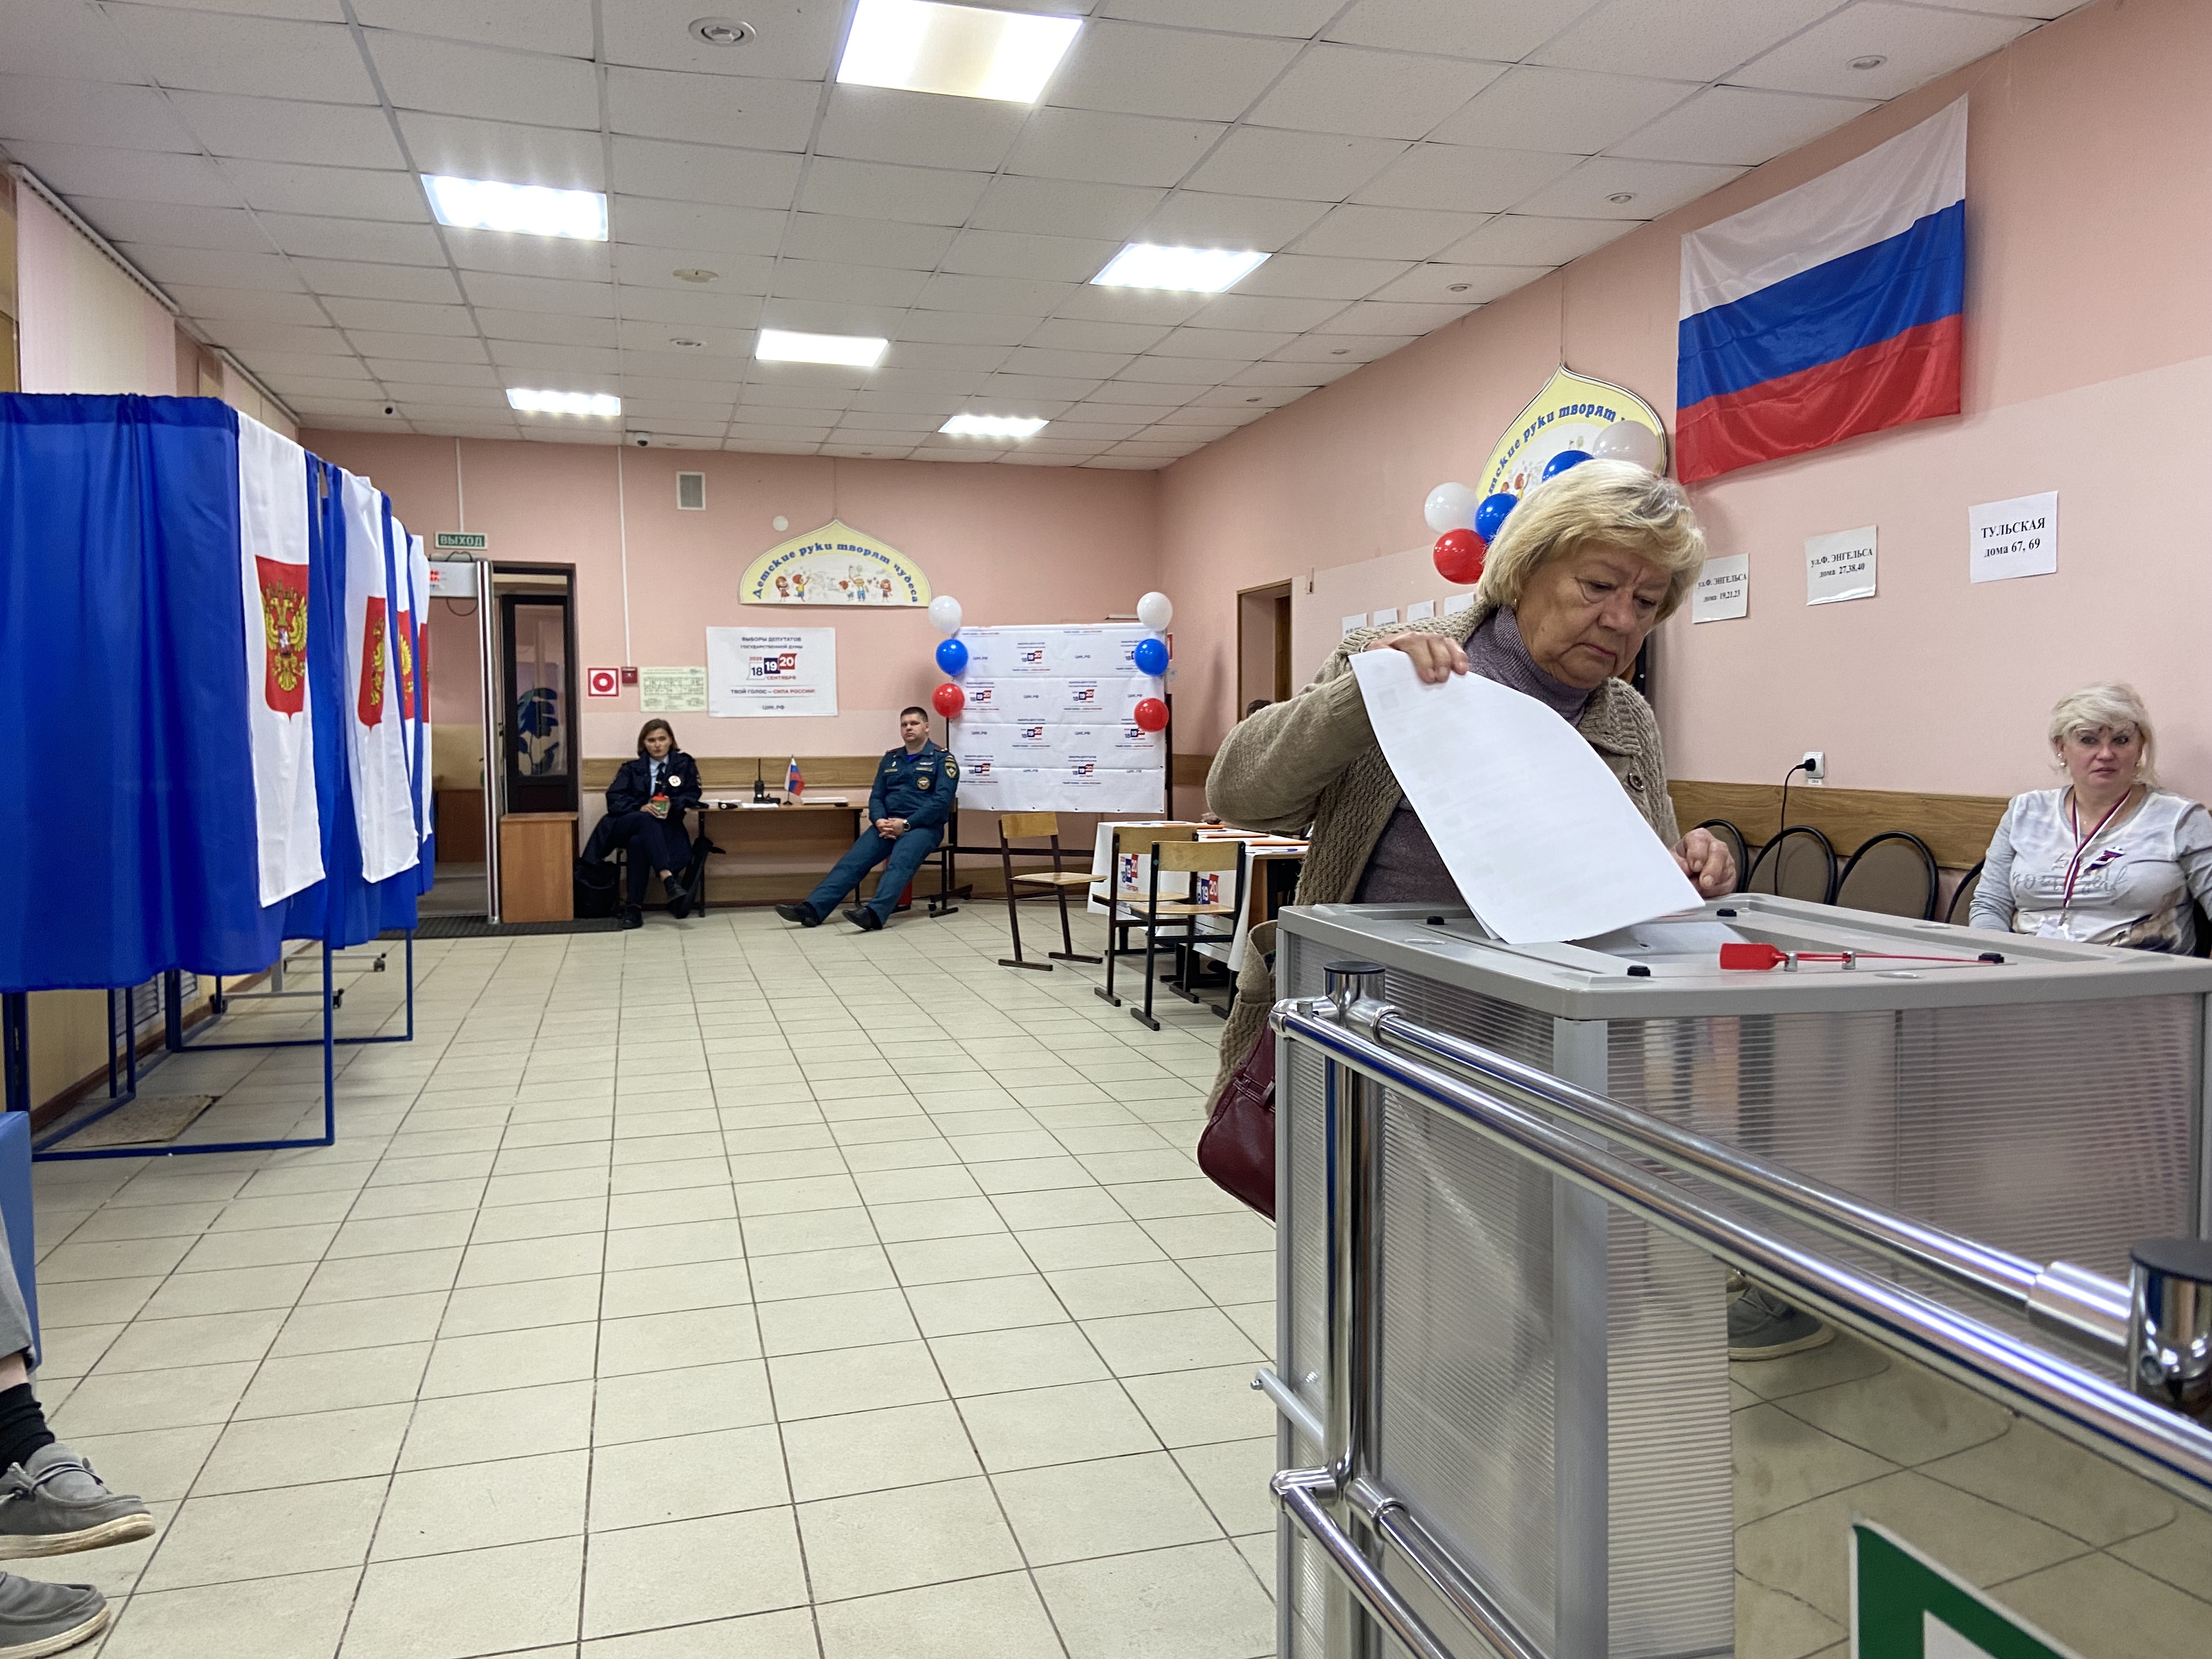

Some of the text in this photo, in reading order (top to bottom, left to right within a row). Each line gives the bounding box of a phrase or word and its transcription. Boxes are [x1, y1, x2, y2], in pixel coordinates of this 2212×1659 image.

[1487, 404, 1616, 495] тские руки творят
[1981, 517, 2046, 538] ТУЛЬСКАЯ
[440, 535, 482, 545] ВЫХОД
[1984, 538, 2040, 558] дома 67, 69
[1831, 548, 1873, 562] ЭНГЕЛЬСА
[753, 543, 918, 602] Детские руки творят чудеса
[1713, 574, 1747, 585] ЭНГЕЛЬСА
[752, 657, 794, 676] 18 19 20
[1209, 879, 1218, 896] 20
